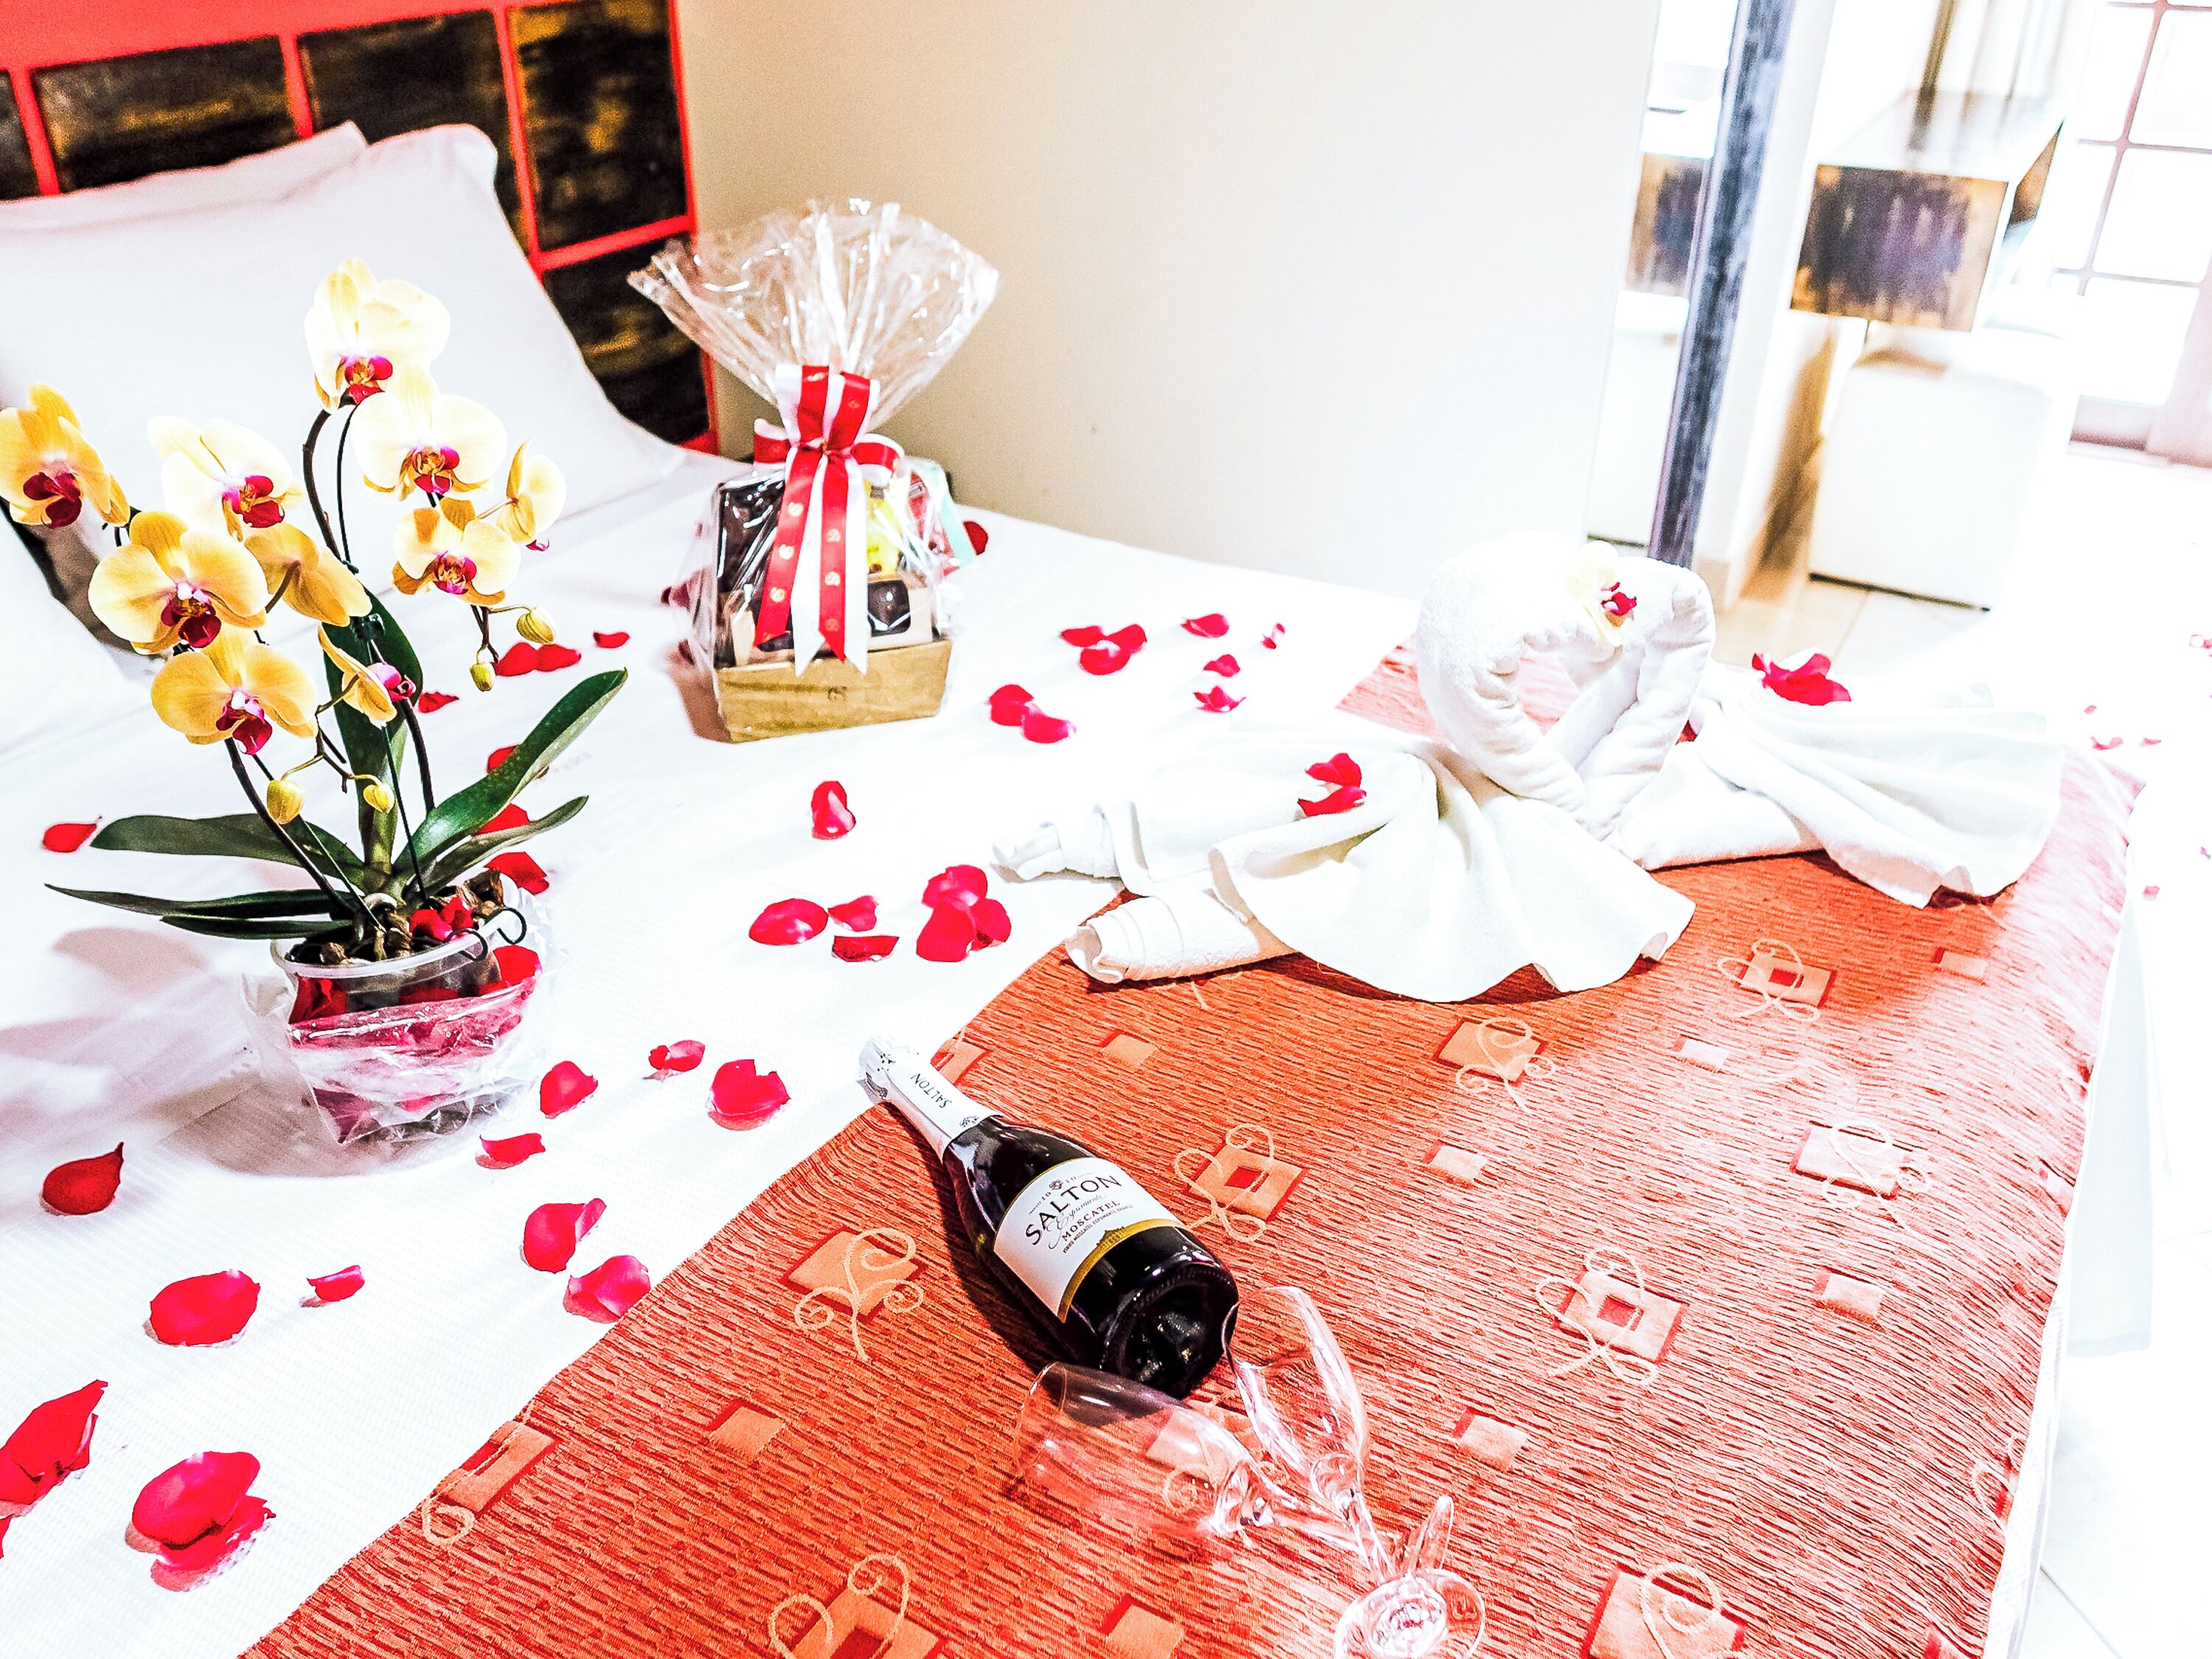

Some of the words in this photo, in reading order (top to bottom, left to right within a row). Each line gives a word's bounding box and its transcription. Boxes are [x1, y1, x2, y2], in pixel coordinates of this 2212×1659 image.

[911, 1074, 952, 1108] SALTON
[1025, 1175, 1122, 1246] SALTON
[1062, 1200, 1120, 1241] MOSCATEL
